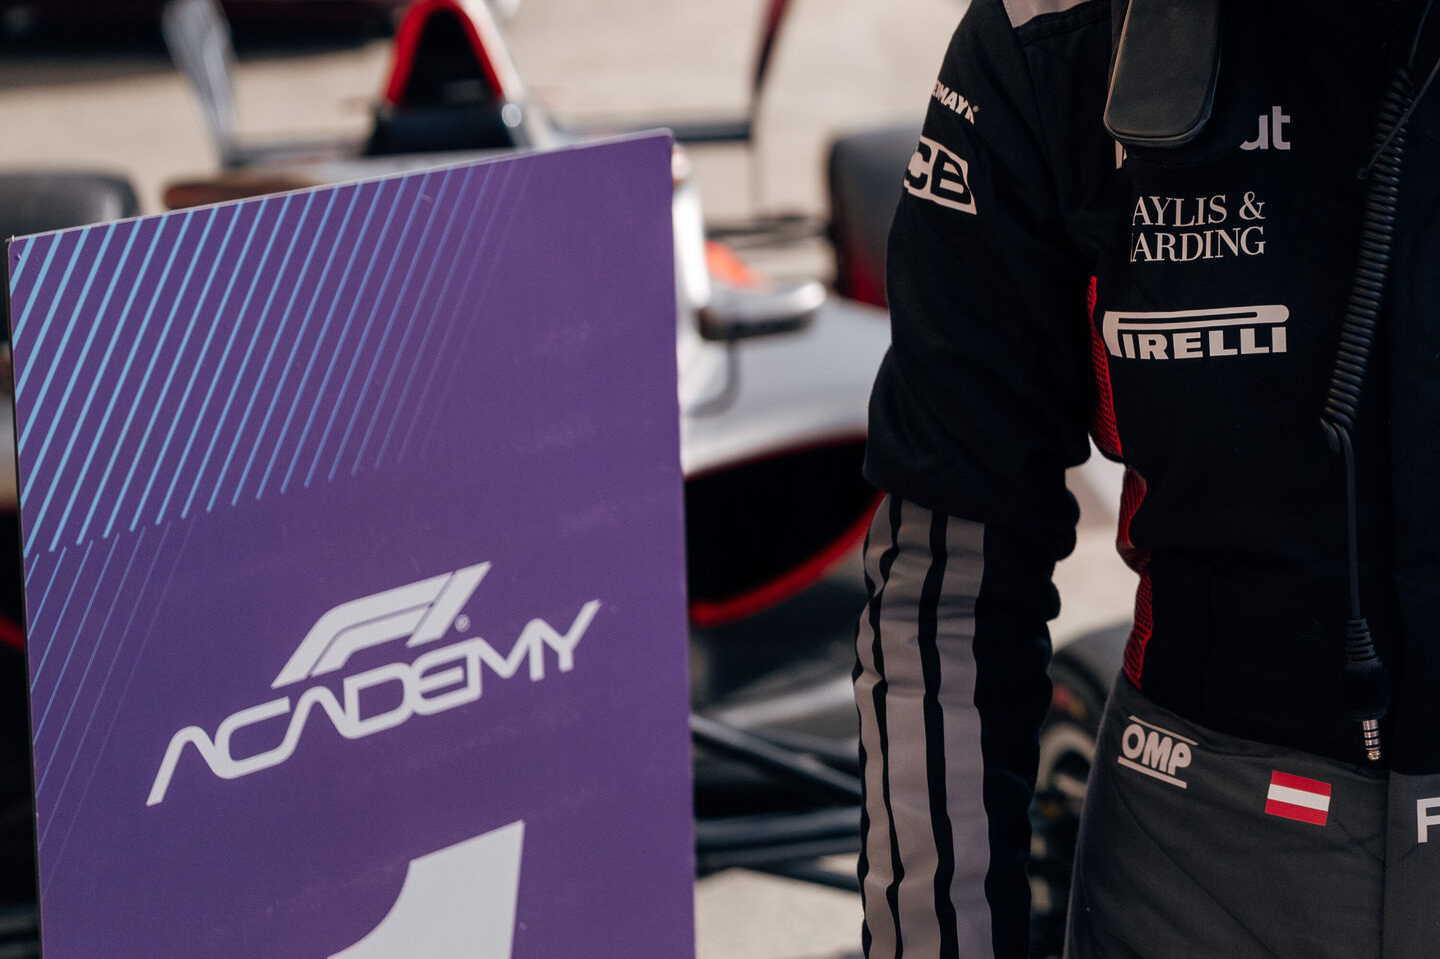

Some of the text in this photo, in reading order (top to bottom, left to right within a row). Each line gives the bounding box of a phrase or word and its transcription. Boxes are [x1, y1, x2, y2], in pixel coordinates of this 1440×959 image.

[1132, 191, 1267, 227] AYLIS &
[1130, 226, 1267, 263] ARDING
[1102, 303, 1291, 361] PIRELLI
[145, 597, 602, 807] ACADEMY
[1120, 722, 1193, 777] OMP
